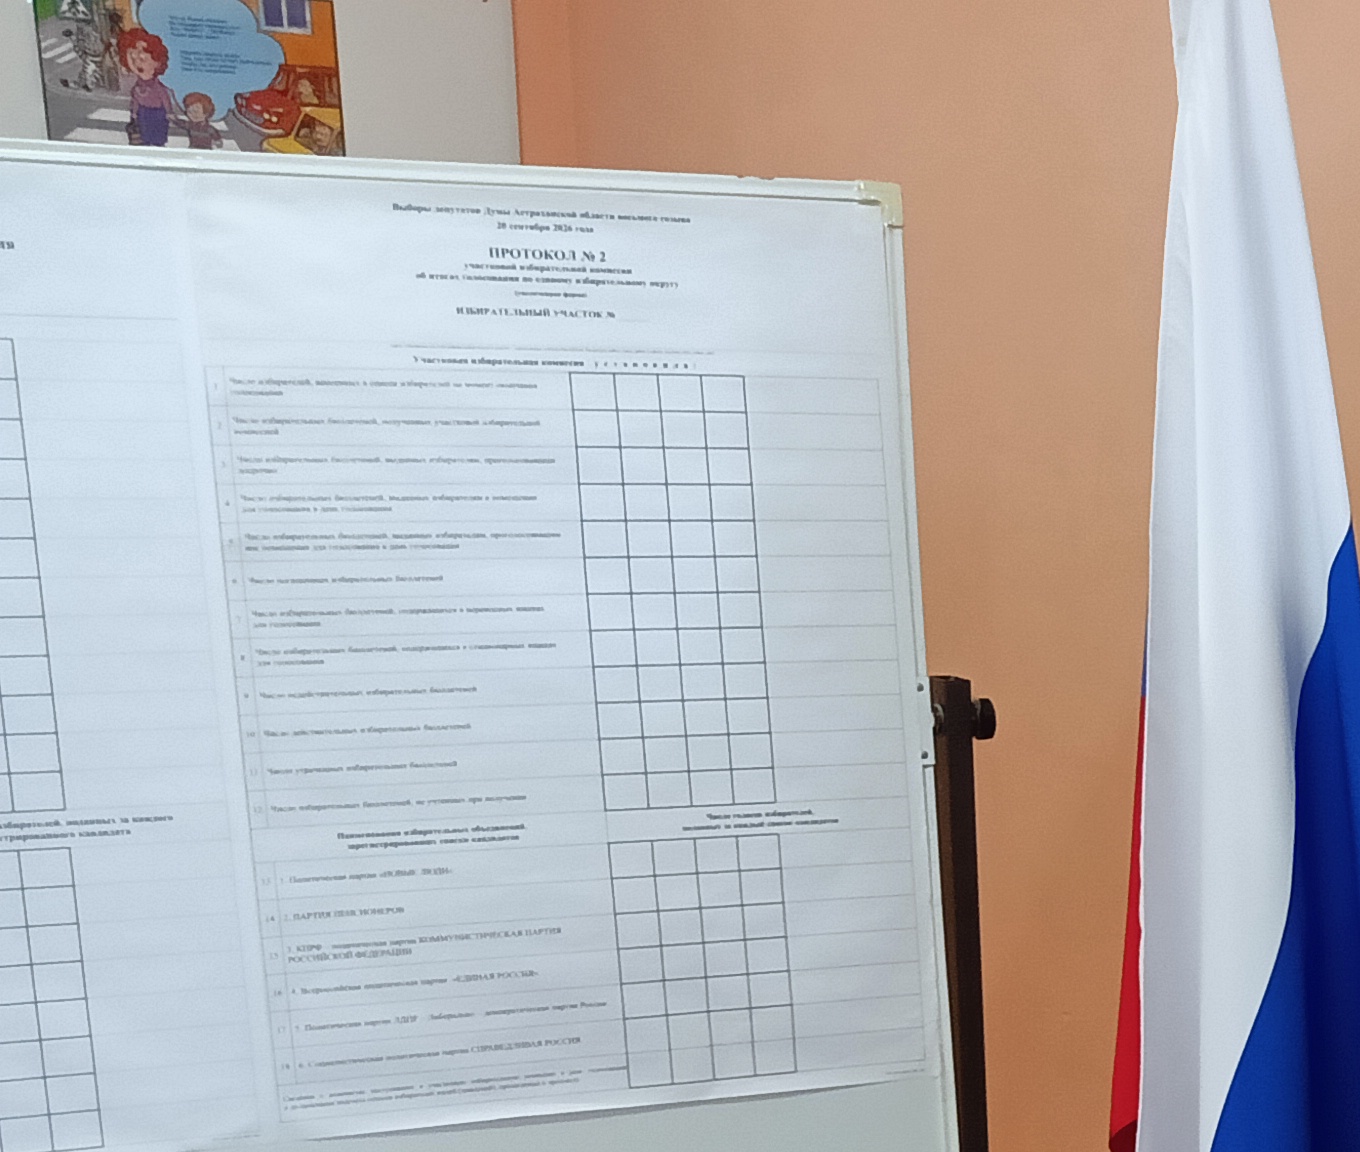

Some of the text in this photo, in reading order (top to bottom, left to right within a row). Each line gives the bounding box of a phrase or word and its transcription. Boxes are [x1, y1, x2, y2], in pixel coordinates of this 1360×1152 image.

[489, 246, 606, 263] ПРОТОКОЛ № 2
[456, 307, 550, 318] ИЗБИРАТЕЛЬНЫЙ
[553, 309, 602, 319] УЧАСТОК
